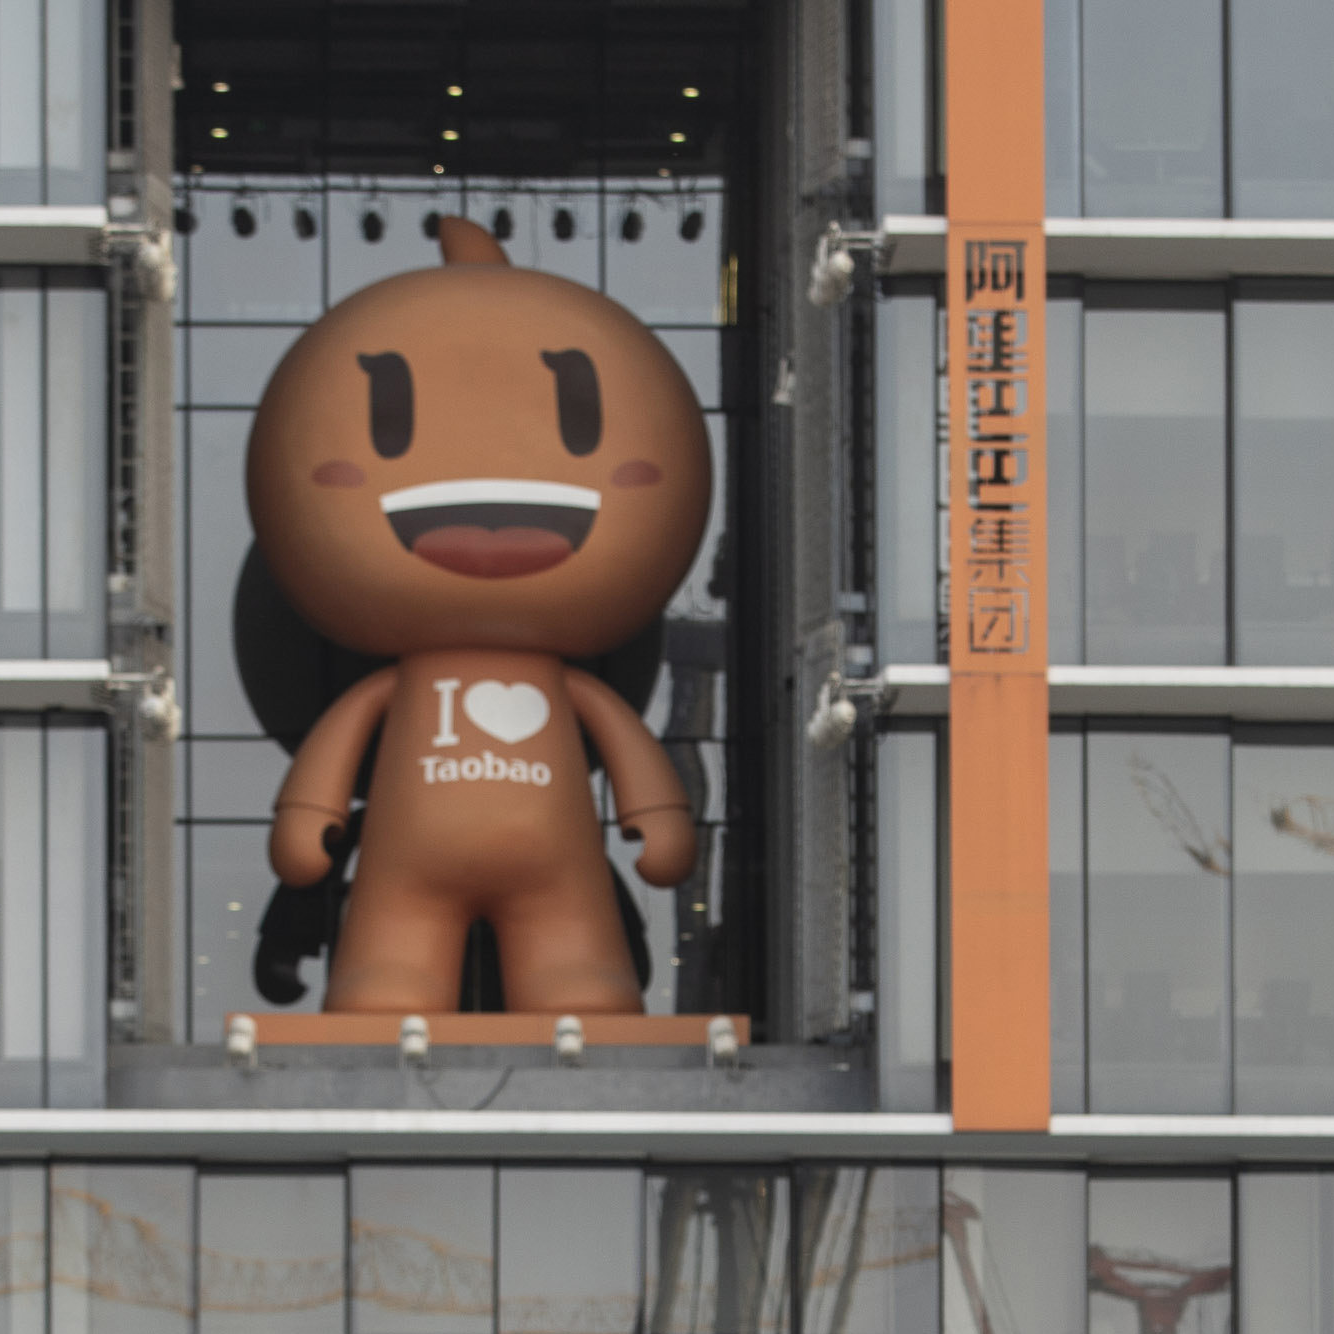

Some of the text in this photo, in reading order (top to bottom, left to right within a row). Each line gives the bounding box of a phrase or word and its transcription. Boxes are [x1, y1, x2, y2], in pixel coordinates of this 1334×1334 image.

[964, 239, 1030, 654] 阿里巴巴集团
[431, 678, 462, 748] I
[420, 750, 552, 787] Taobao
